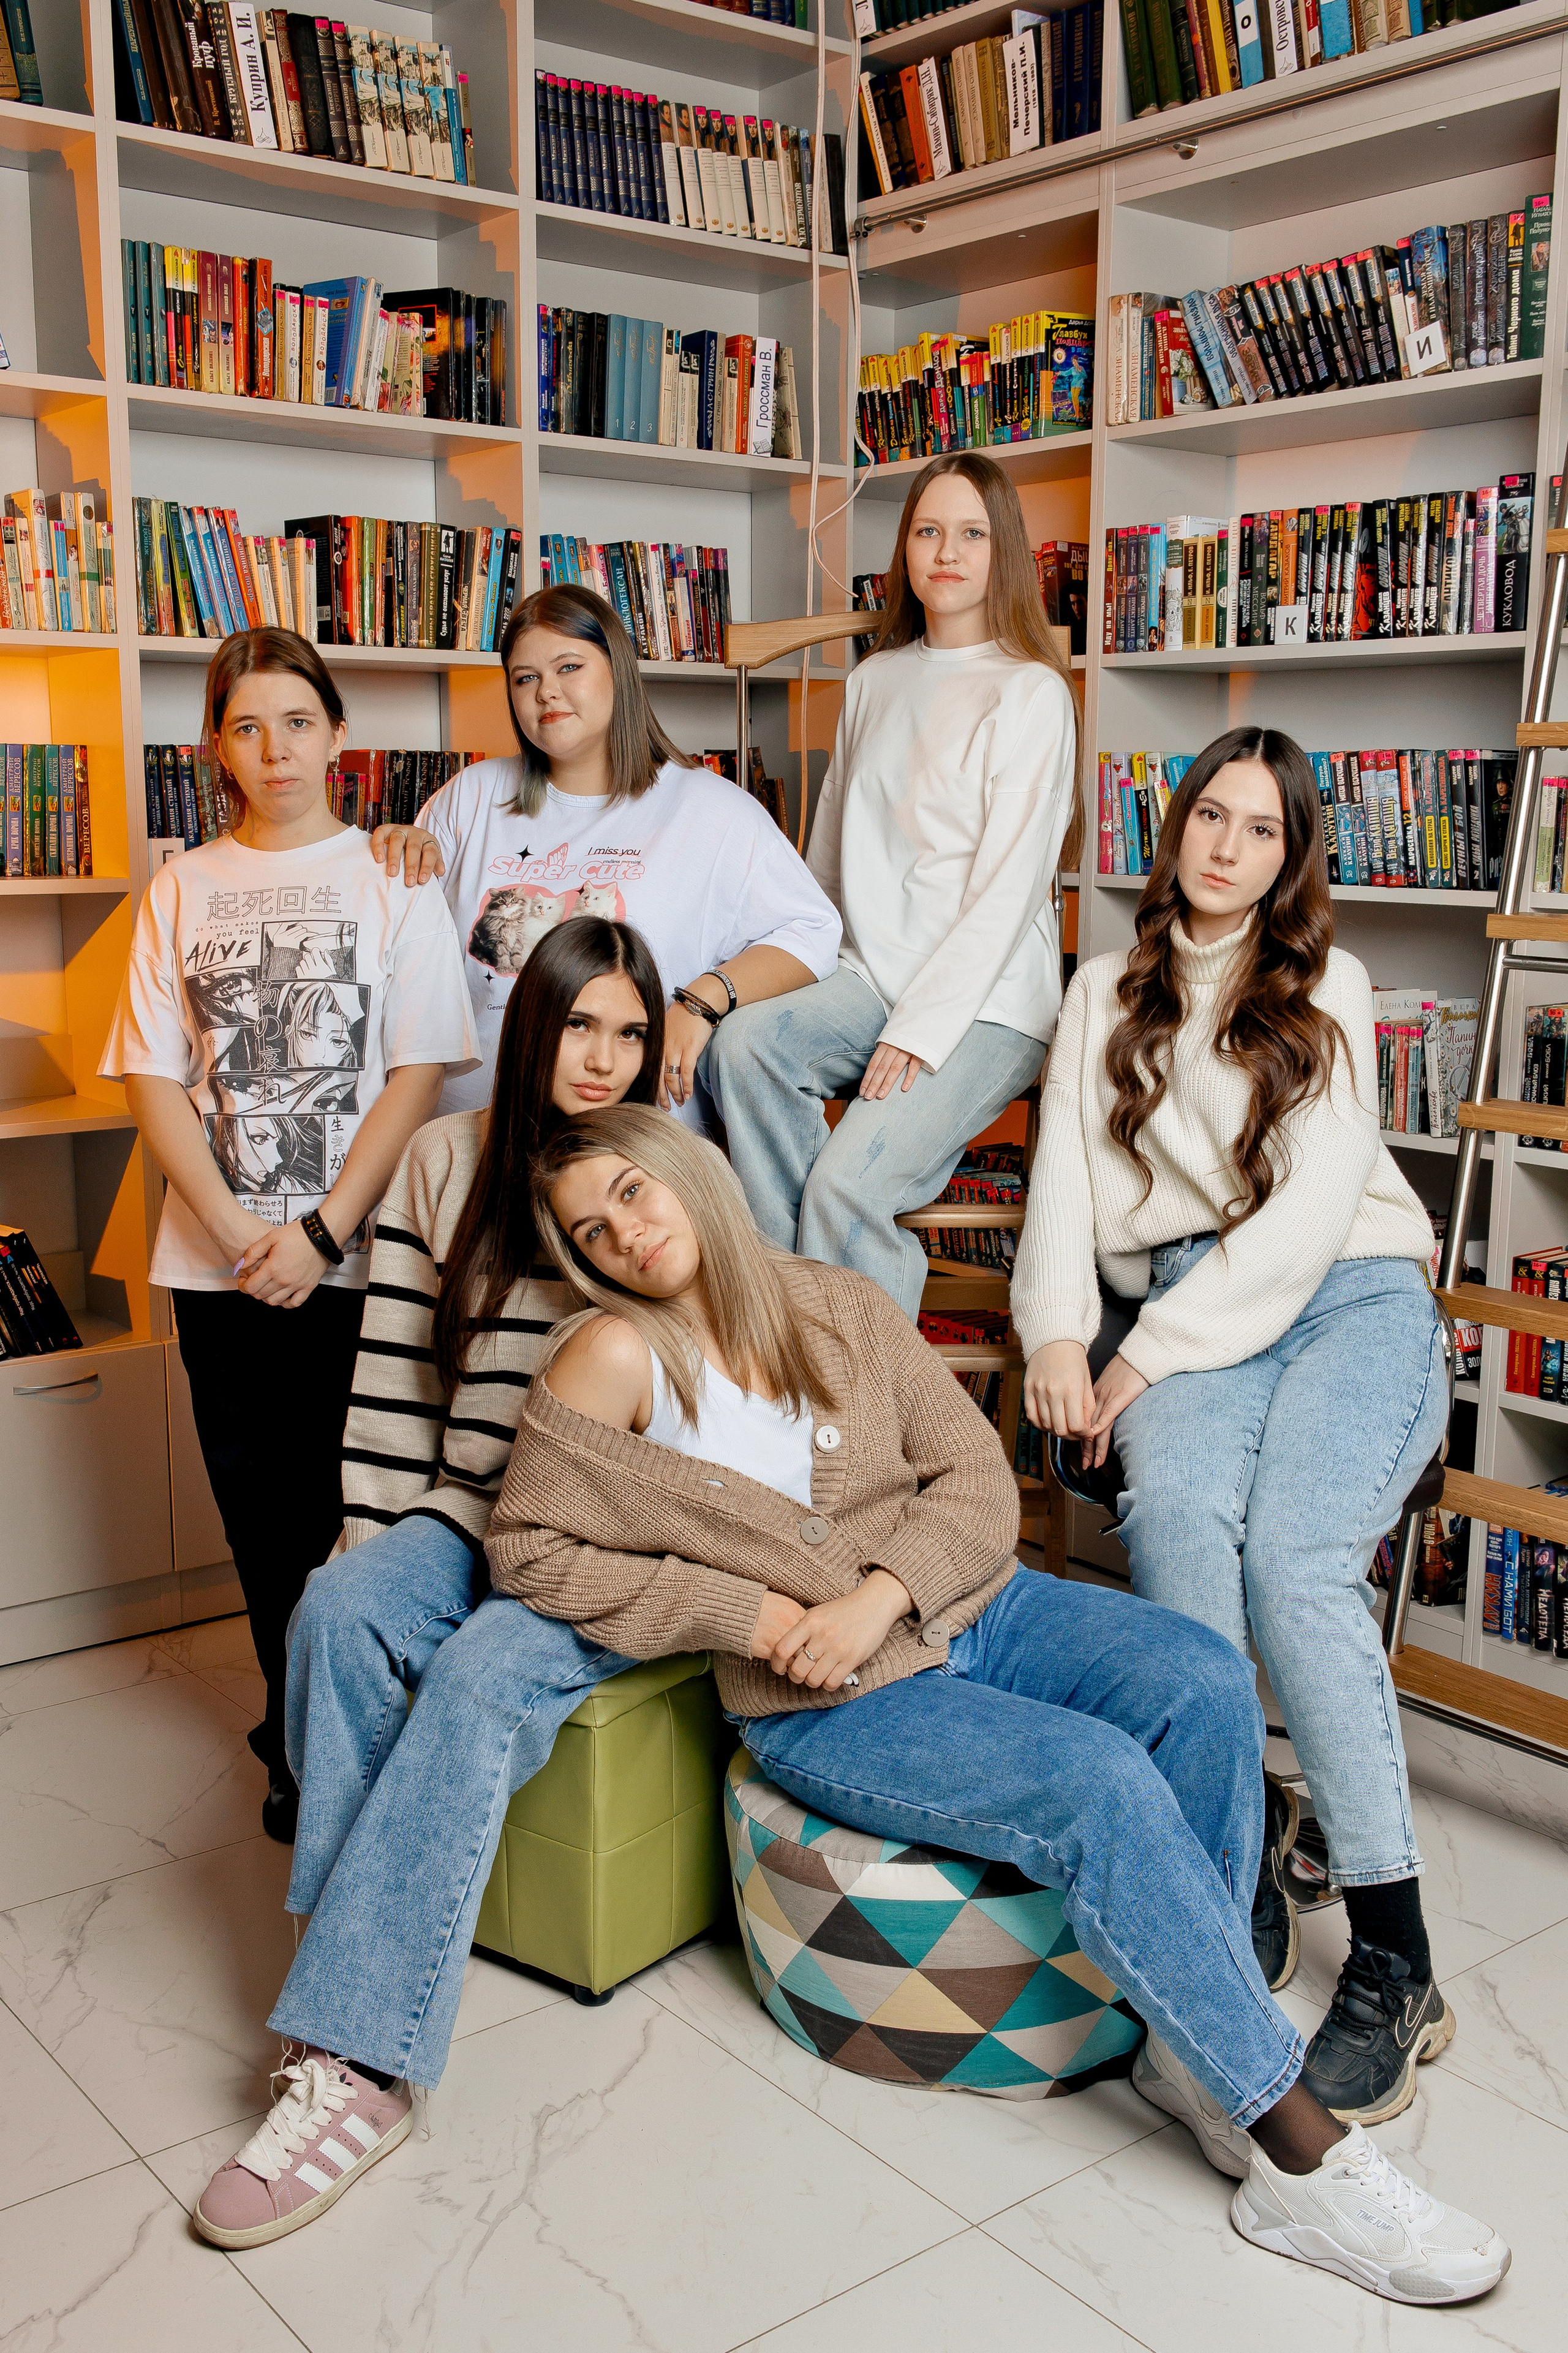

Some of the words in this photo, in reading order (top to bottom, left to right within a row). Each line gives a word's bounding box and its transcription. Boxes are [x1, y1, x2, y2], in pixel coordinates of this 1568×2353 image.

[235, 12, 252, 29] И.
[240, 34, 256, 50] А.
[246, 54, 269, 113] Куприн
[920, 66, 937, 86] Д.Н.
[1011, 58, 1020, 129] Мельников-
[1021, 70, 1031, 137] Печерский
[926, 86, 944, 159] Мамин-Сибиряк
[1511, 269, 1520, 294] дома
[1507, 297, 1521, 333] Черного
[760, 348, 772, 361] В.
[1416, 335, 1433, 360] И
[1507, 334, 1517, 360] Тайна
[756, 364, 772, 428] Гроссман
[630, 421, 636, 429] 2
[647, 423, 653, 432] 3
[237, 542, 248, 574] клиника
[244, 576, 254, 602] потерь
[1251, 586, 1260, 625] МЕССИНГ
[1502, 559, 1517, 627] КУКЛОВОД
[1284, 616, 1297, 636] К
[186, 807, 195, 843] АКАДЕМИЯ
[1403, 813, 1412, 825] 12
[1453, 804, 1464, 827] БОЙ
[82, 807, 91, 854] ВЕРЕСОВ
[1325, 804, 1338, 855] КАЛУГИН
[1427, 829, 1433, 838] НА
[592, 847, 619, 856] miss
[620, 847, 641, 856] you
[1344, 836, 1353, 866] КАЛУГИН
[1455, 831, 1467, 877] ВЕЧНЫЙ
[487, 855, 578, 883] Super
[578, 860, 646, 880] Cute
[1474, 870, 1479, 880] 2
[206, 886, 342, 921] 起死回生
[216, 929, 235, 939] you
[239, 927, 260, 936] feel
[1380, 1001, 1401, 1010] ЕЛЕНА
[252, 980, 287, 1106] 物の哀れ
[1447, 1026, 1477, 1044] Папин
[1505, 1560, 1514, 1570] С
[1504, 1572, 1515, 1607] НАМИ
[1502, 1608, 1513, 1634] БОТ
